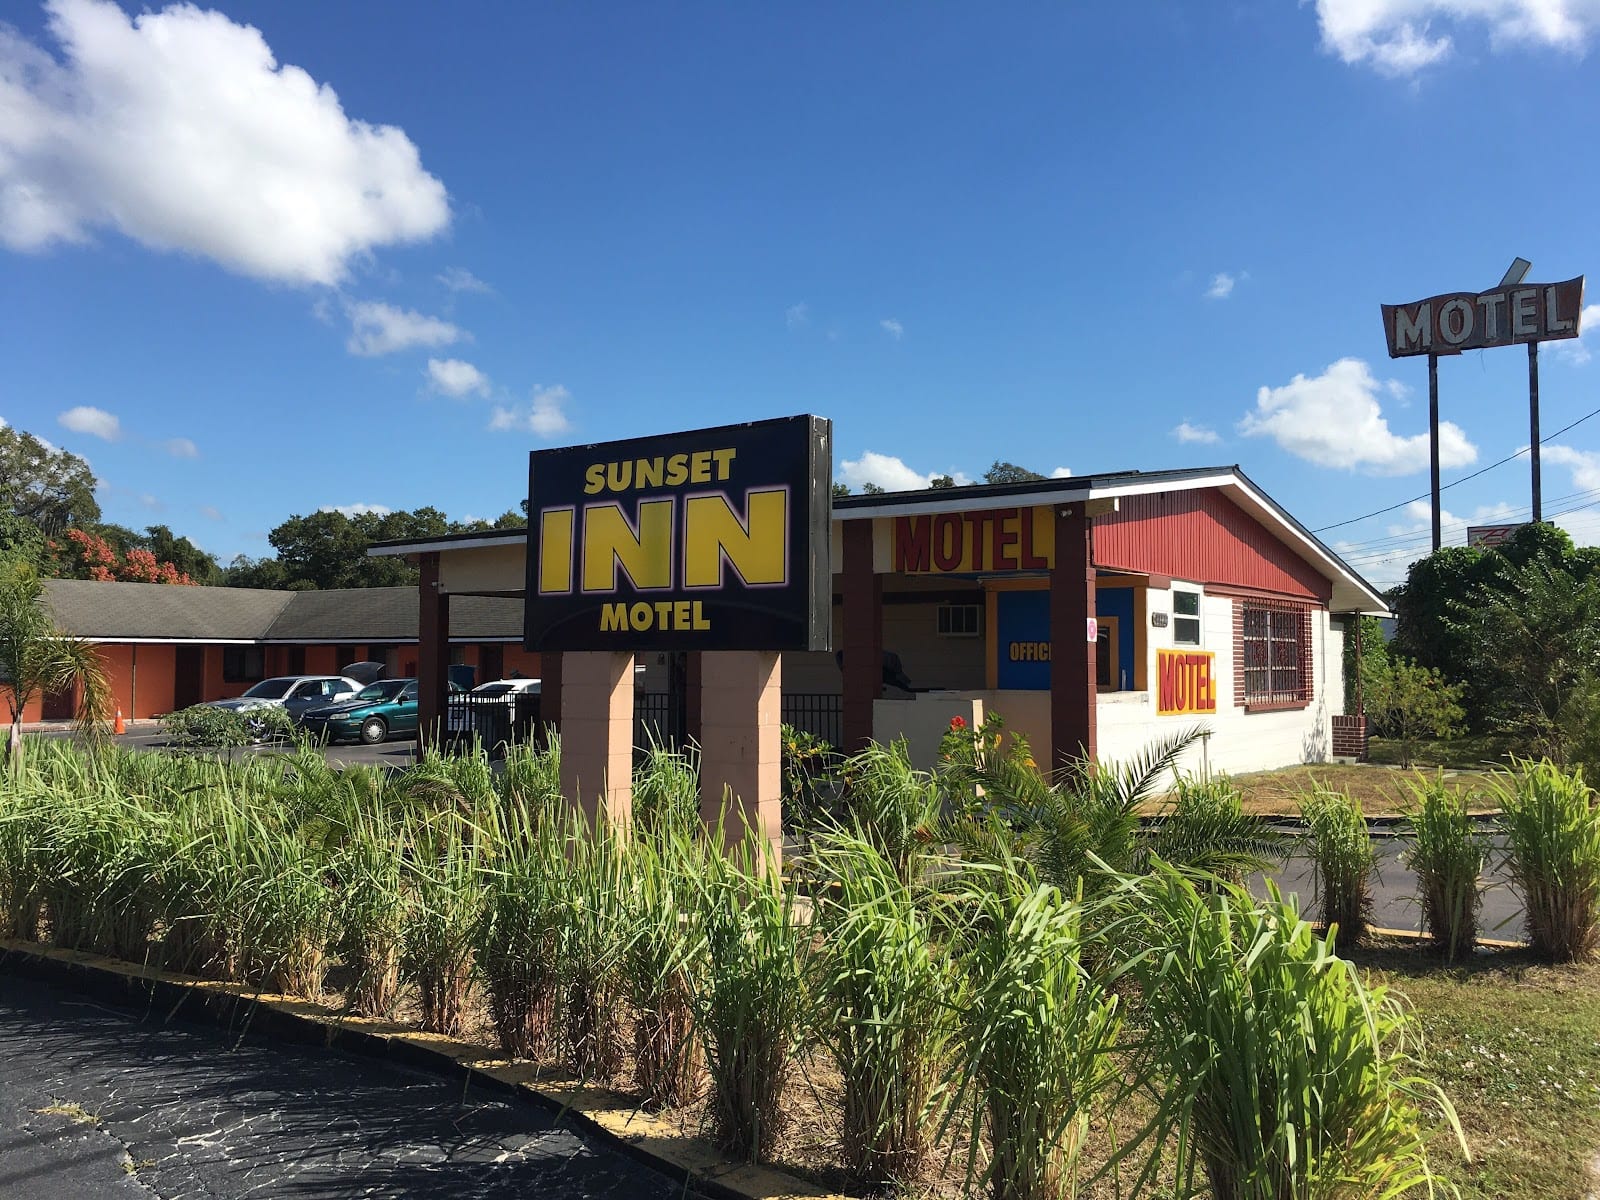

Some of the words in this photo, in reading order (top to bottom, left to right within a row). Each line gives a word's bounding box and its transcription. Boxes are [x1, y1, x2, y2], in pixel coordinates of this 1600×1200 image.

[1395, 286, 1573, 350] MOTEL
[584, 448, 737, 494] SUNSET
[540, 489, 787, 593] INN
[895, 505, 1049, 571] MOTEL
[600, 601, 711, 632] MOTEL
[1158, 652, 1216, 712] MOTEL
